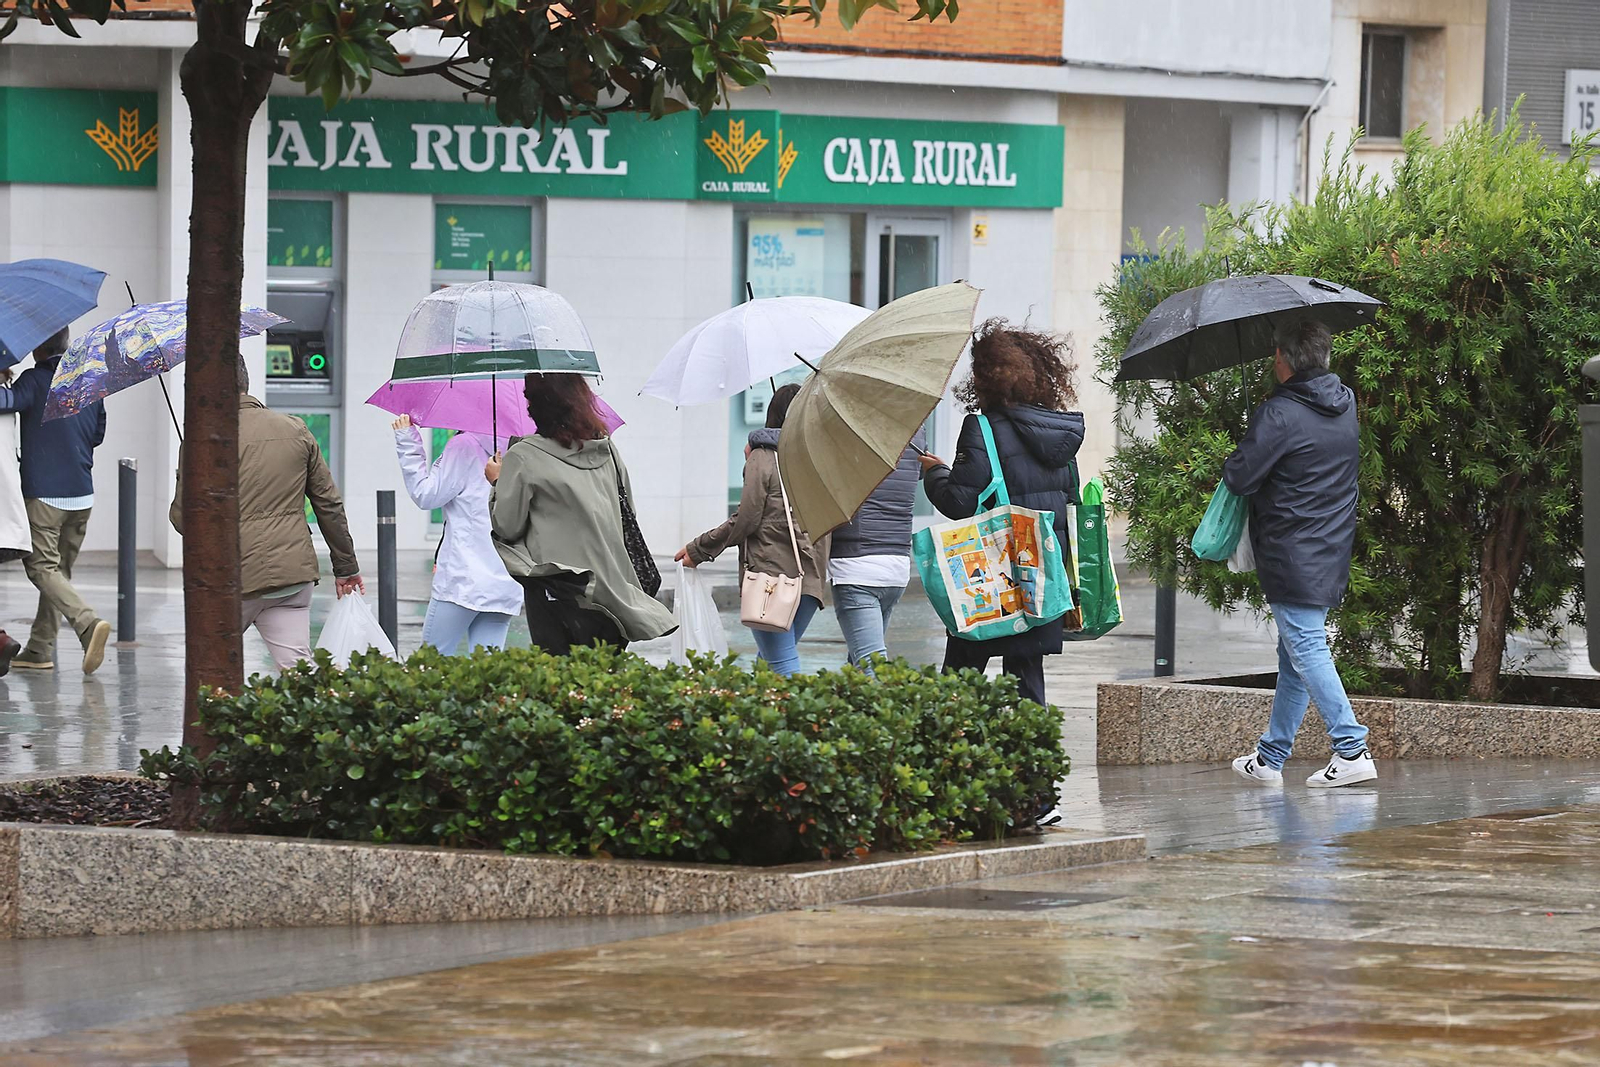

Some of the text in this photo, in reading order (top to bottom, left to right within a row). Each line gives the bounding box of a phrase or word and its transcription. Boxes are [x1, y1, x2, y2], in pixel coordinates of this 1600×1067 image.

[1579, 101, 1595, 130] 15
[268, 120, 628, 175] AJA RURAL
[824, 137, 1017, 187] CAJA RURAL
[702, 181, 770, 193] CAJA RURAL
[752, 234, 783, 256] 95%
